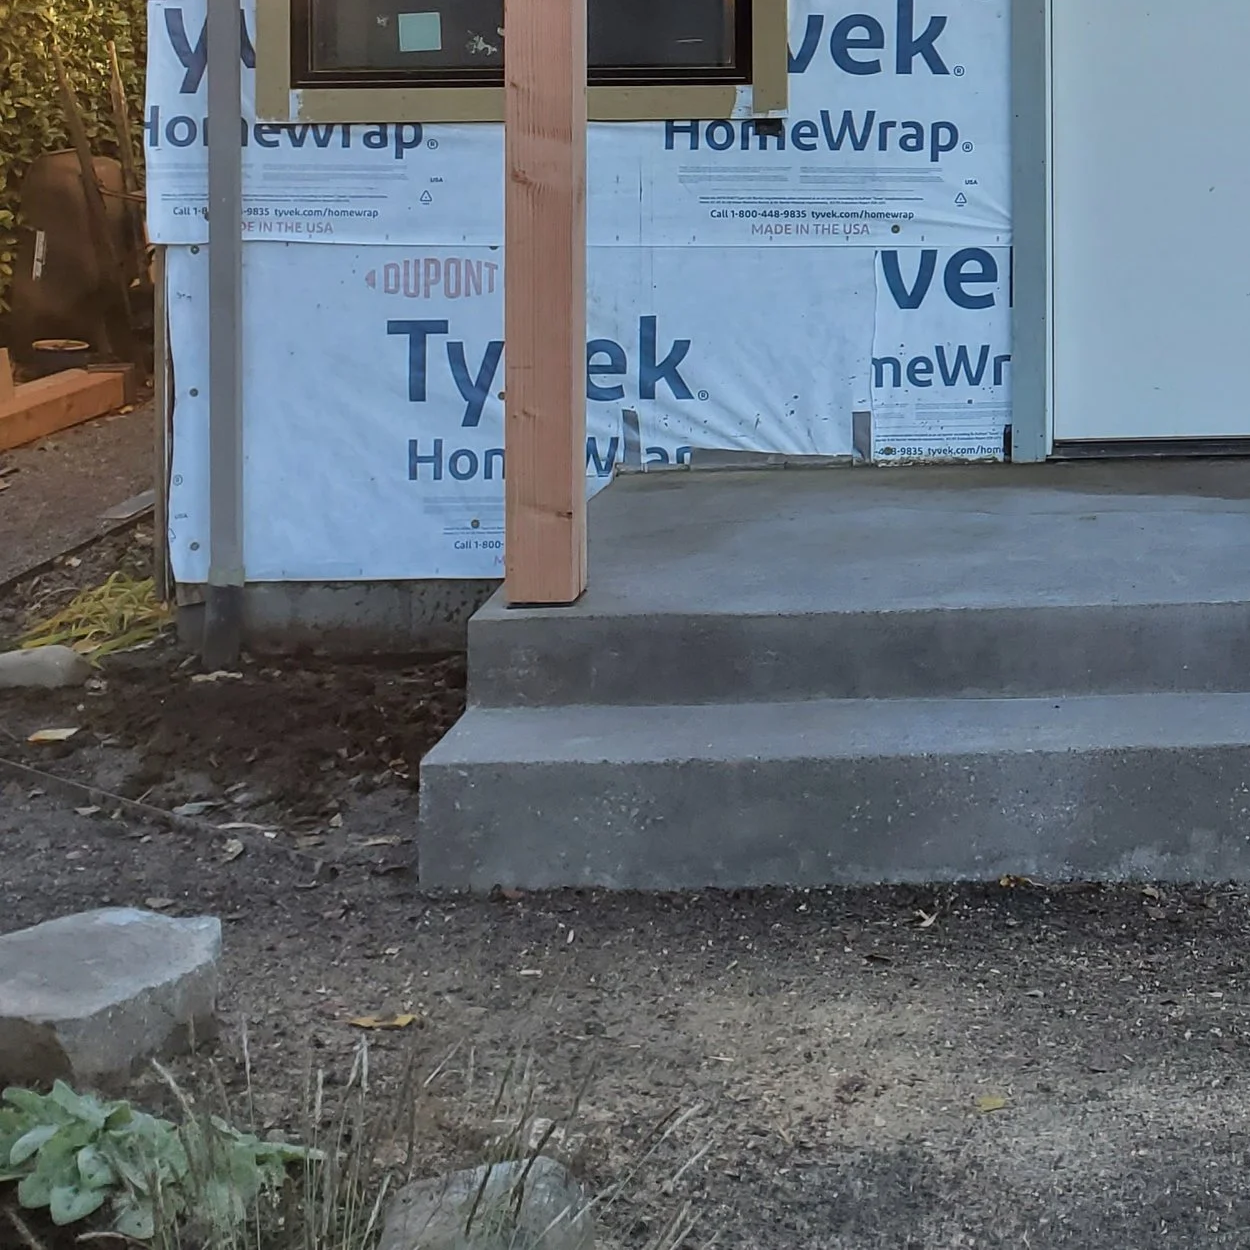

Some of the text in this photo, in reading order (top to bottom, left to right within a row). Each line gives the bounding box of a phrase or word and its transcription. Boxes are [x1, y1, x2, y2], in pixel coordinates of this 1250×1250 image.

[173, 207, 190, 217] Call
[274, 207, 379, 219] tyvek.com/homewrap
[710, 209, 914, 221] Call 1-800-448-9835 tyvek.com/homewrap
[259, 221, 272, 232] IN
[276, 221, 302, 233] THE
[306, 221, 333, 233] USA
[751, 224, 870, 235] MADE IN THE USA
[383, 258, 499, 299] DUPONT
[454, 540, 472, 549] Call
